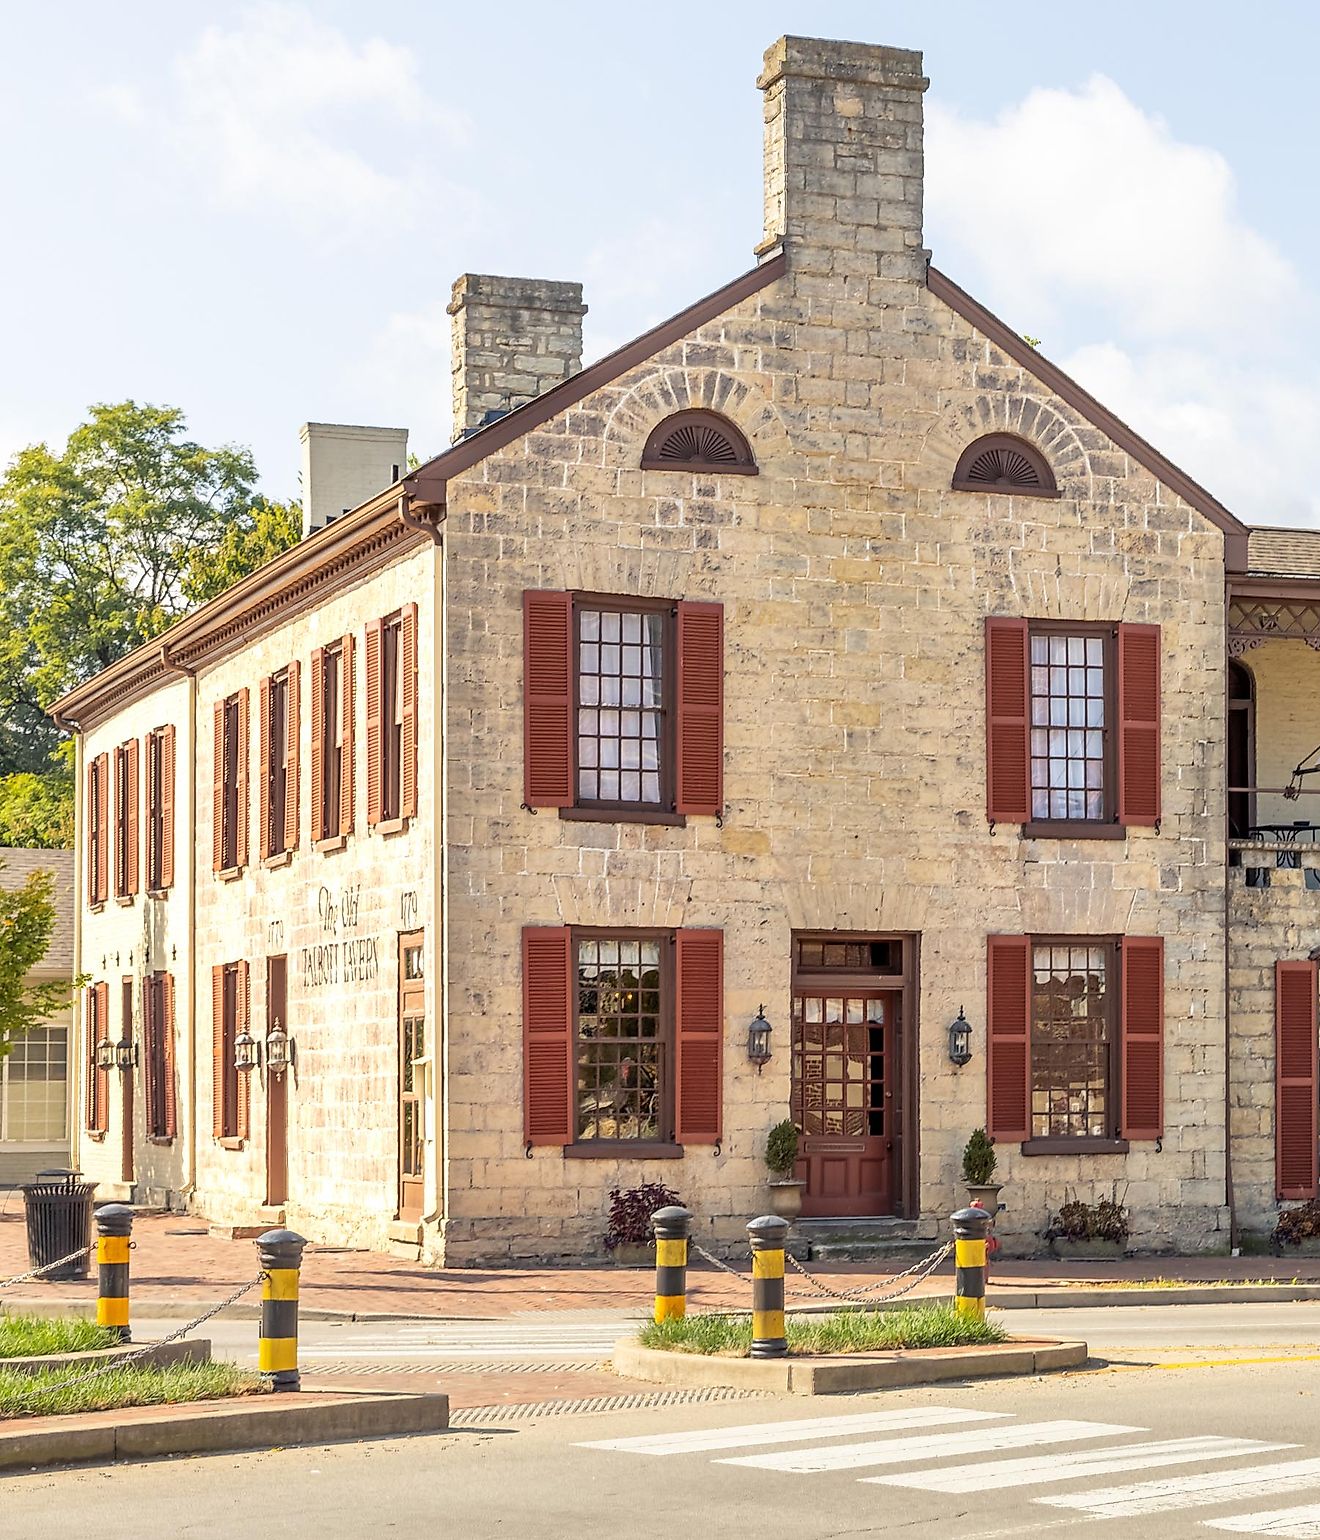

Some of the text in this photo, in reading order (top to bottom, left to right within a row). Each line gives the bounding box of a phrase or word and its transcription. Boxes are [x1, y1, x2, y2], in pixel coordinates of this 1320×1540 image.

[341, 884, 361, 928] Old
[400, 890, 418, 929] 1779
[268, 920, 284, 947] 1779
[302, 937, 380, 988] TALBOTT TAVERN
